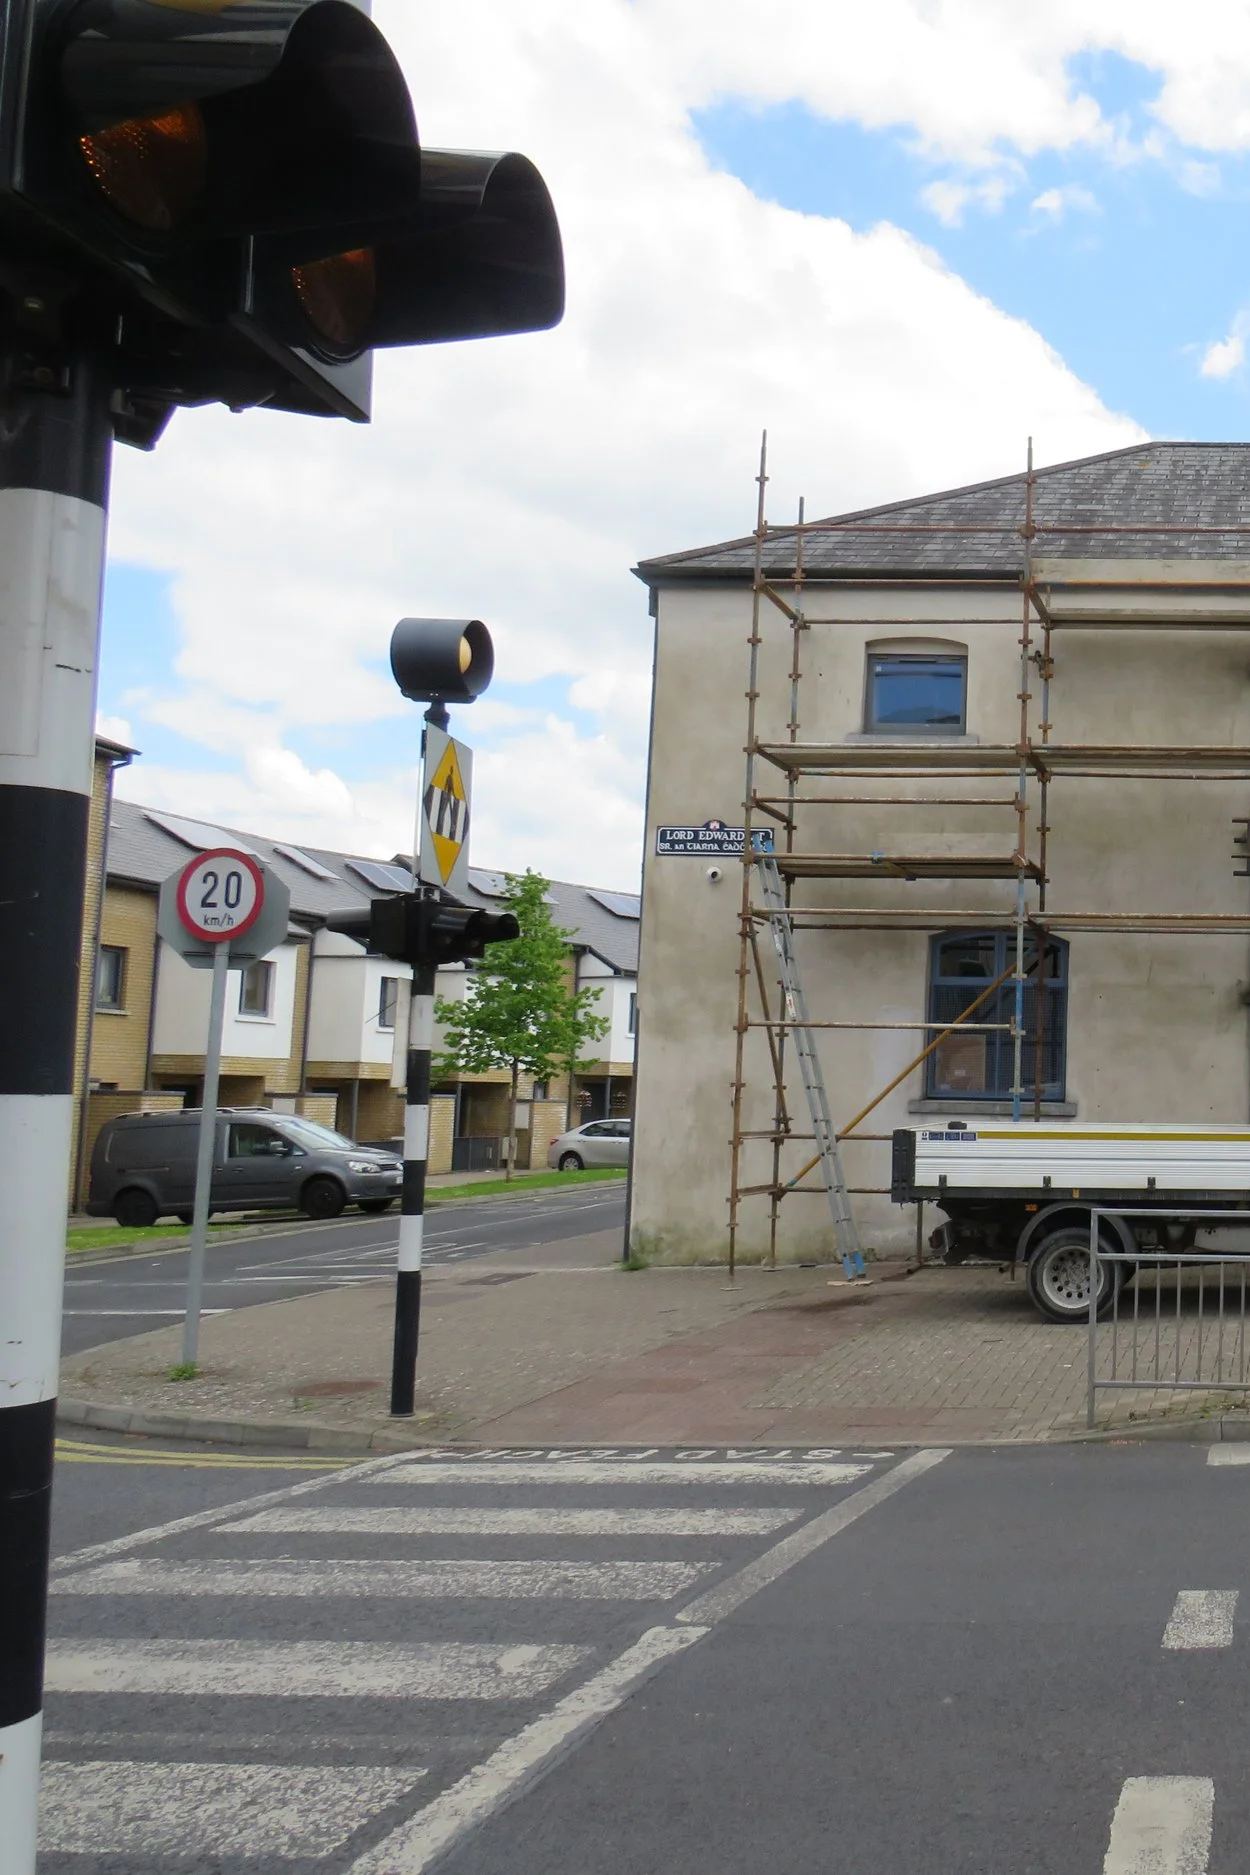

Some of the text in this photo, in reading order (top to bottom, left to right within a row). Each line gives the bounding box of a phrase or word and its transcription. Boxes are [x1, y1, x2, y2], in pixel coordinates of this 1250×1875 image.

[666, 830, 694, 840] LORD
[699, 831, 745, 841] EDWARD
[200, 871, 242, 909] 20
[203, 912, 234, 927] km/h
[673, 1448, 842, 1460] STAD
